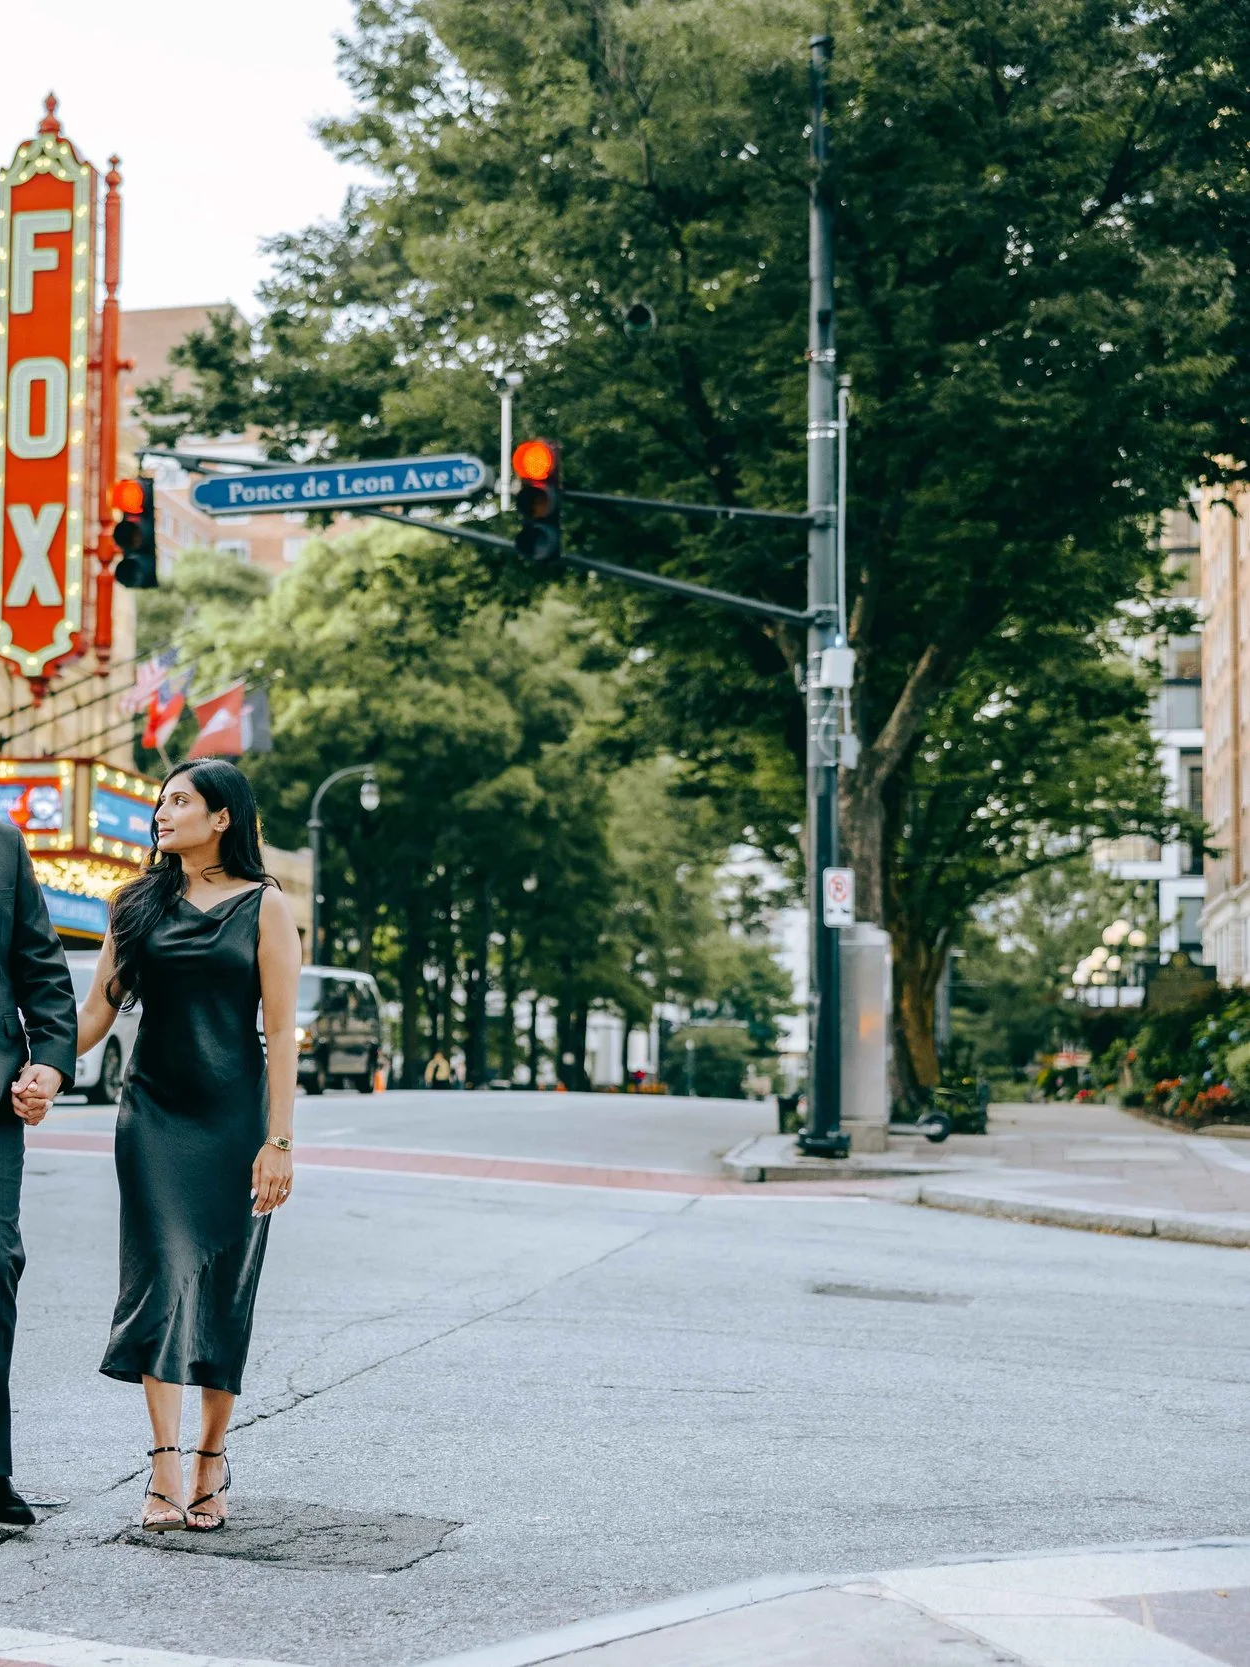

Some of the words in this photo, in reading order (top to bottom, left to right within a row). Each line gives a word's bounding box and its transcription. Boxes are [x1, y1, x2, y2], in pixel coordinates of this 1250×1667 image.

[5, 210, 72, 607] FOX
[228, 482, 295, 503] Ponce
[301, 474, 330, 498] de
[337, 473, 395, 496] Leon
[402, 468, 448, 490] Ave
[452, 466, 477, 483] NE
